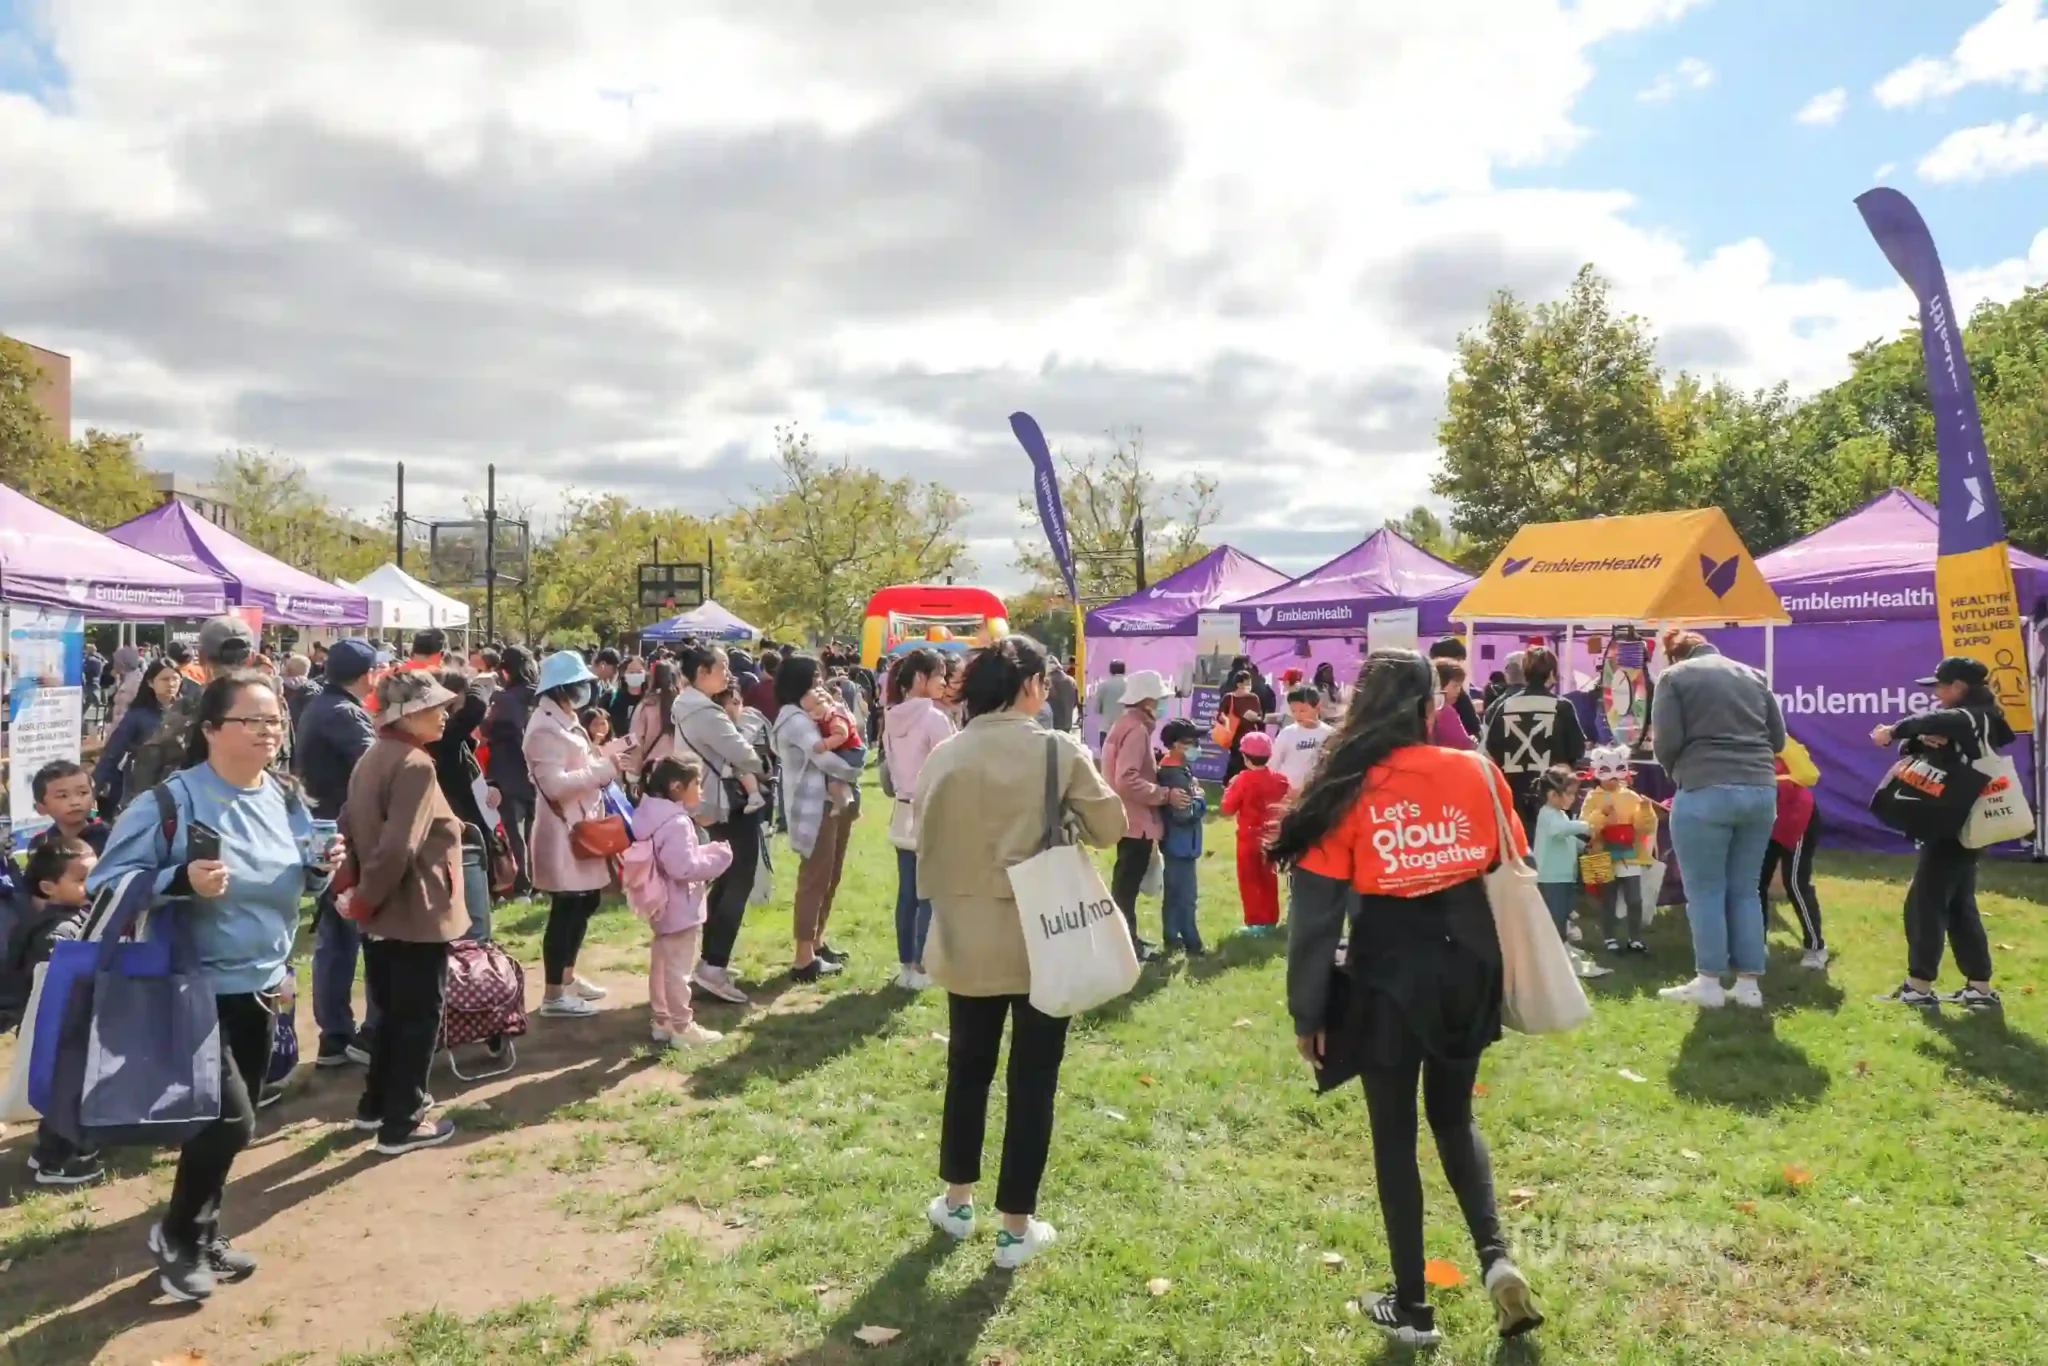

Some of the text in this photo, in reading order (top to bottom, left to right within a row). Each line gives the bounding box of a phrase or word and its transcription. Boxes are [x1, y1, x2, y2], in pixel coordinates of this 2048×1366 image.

[1529, 553, 1663, 574] EmblemHealth
[95, 583, 185, 606] EmblemHealth
[1780, 587, 1935, 612] EmblemHealth
[1276, 605, 1352, 622] EmblemHealth
[1986, 795, 2004, 805] THE
[1370, 800, 1421, 824] Let's
[1983, 805, 2014, 819] HATE
[1372, 819, 1457, 874] glow
[1398, 843, 1488, 870] together
